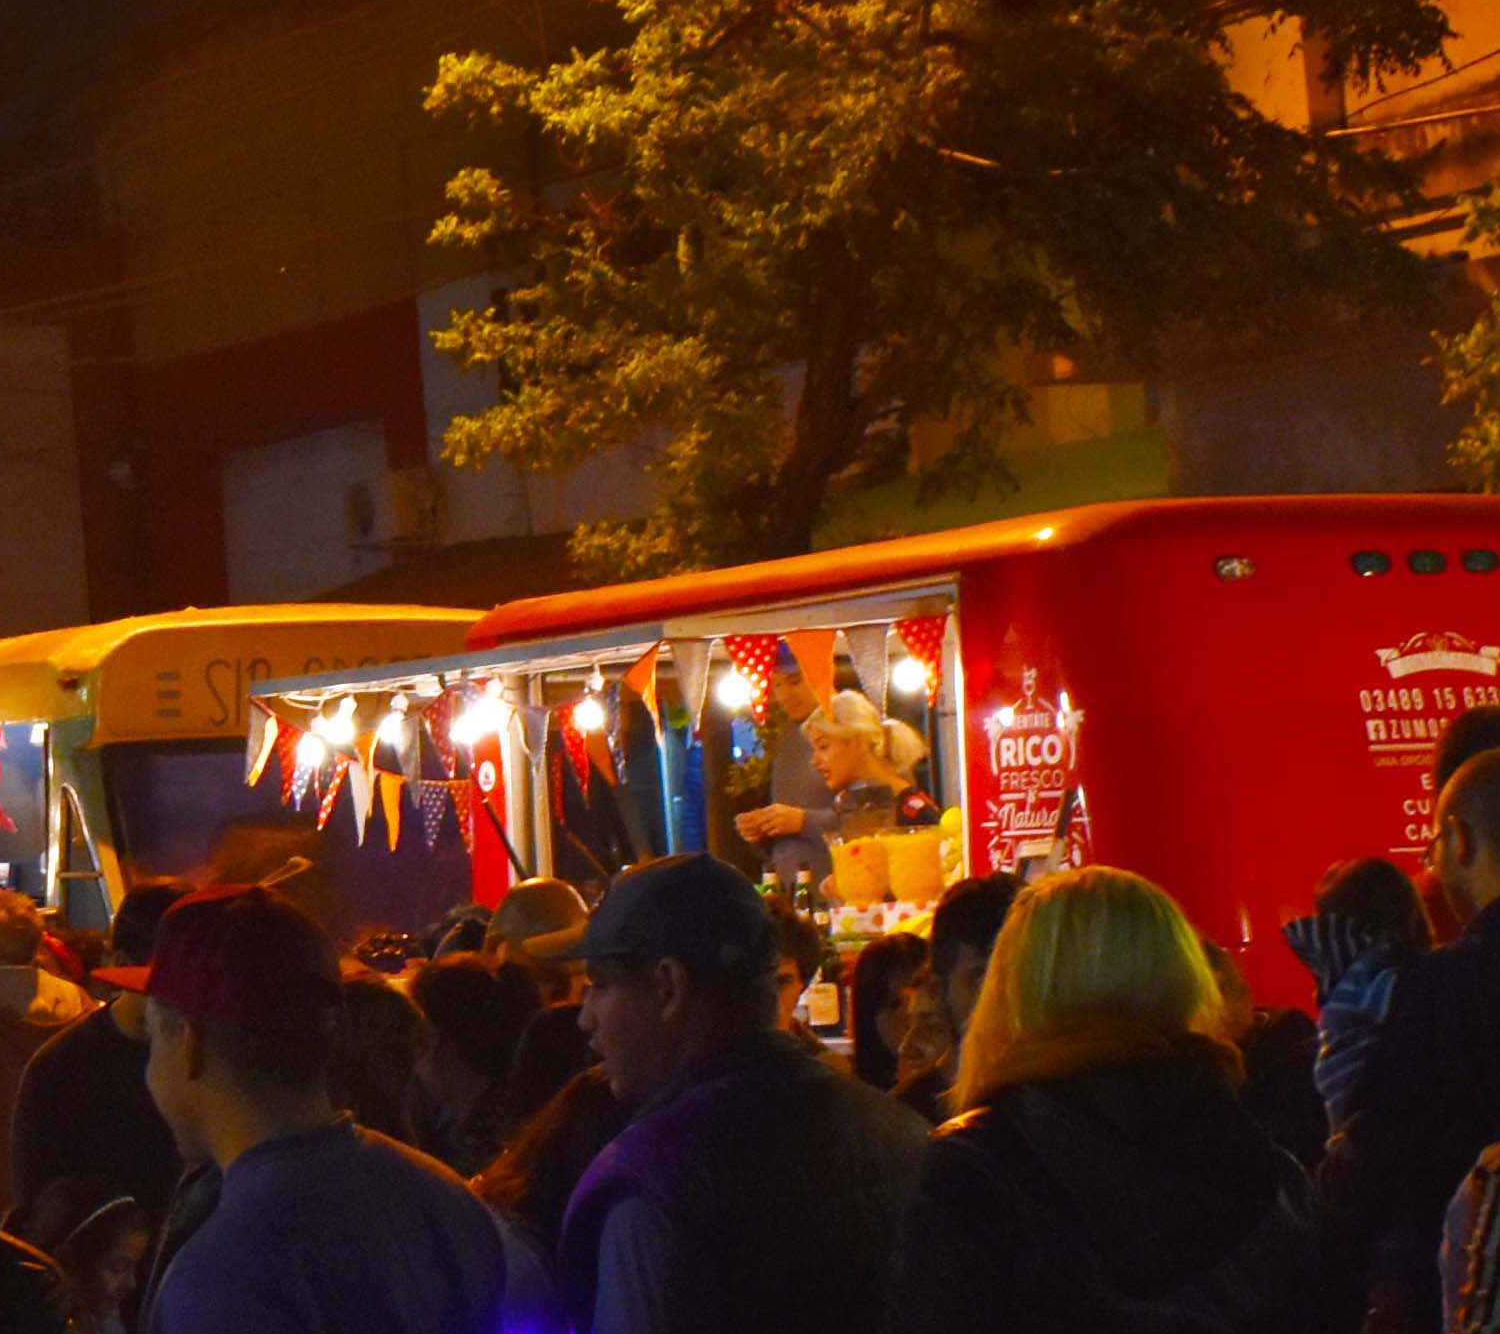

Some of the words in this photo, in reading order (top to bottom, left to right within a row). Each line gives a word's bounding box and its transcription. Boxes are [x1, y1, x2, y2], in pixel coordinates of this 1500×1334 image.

[1359, 687, 1424, 713] 03489
[1433, 686, 1457, 710] 15
[1000, 734, 1063, 767] RICO
[1000, 769, 1065, 791] FRESCO
[1000, 801, 1059, 830] Natura
